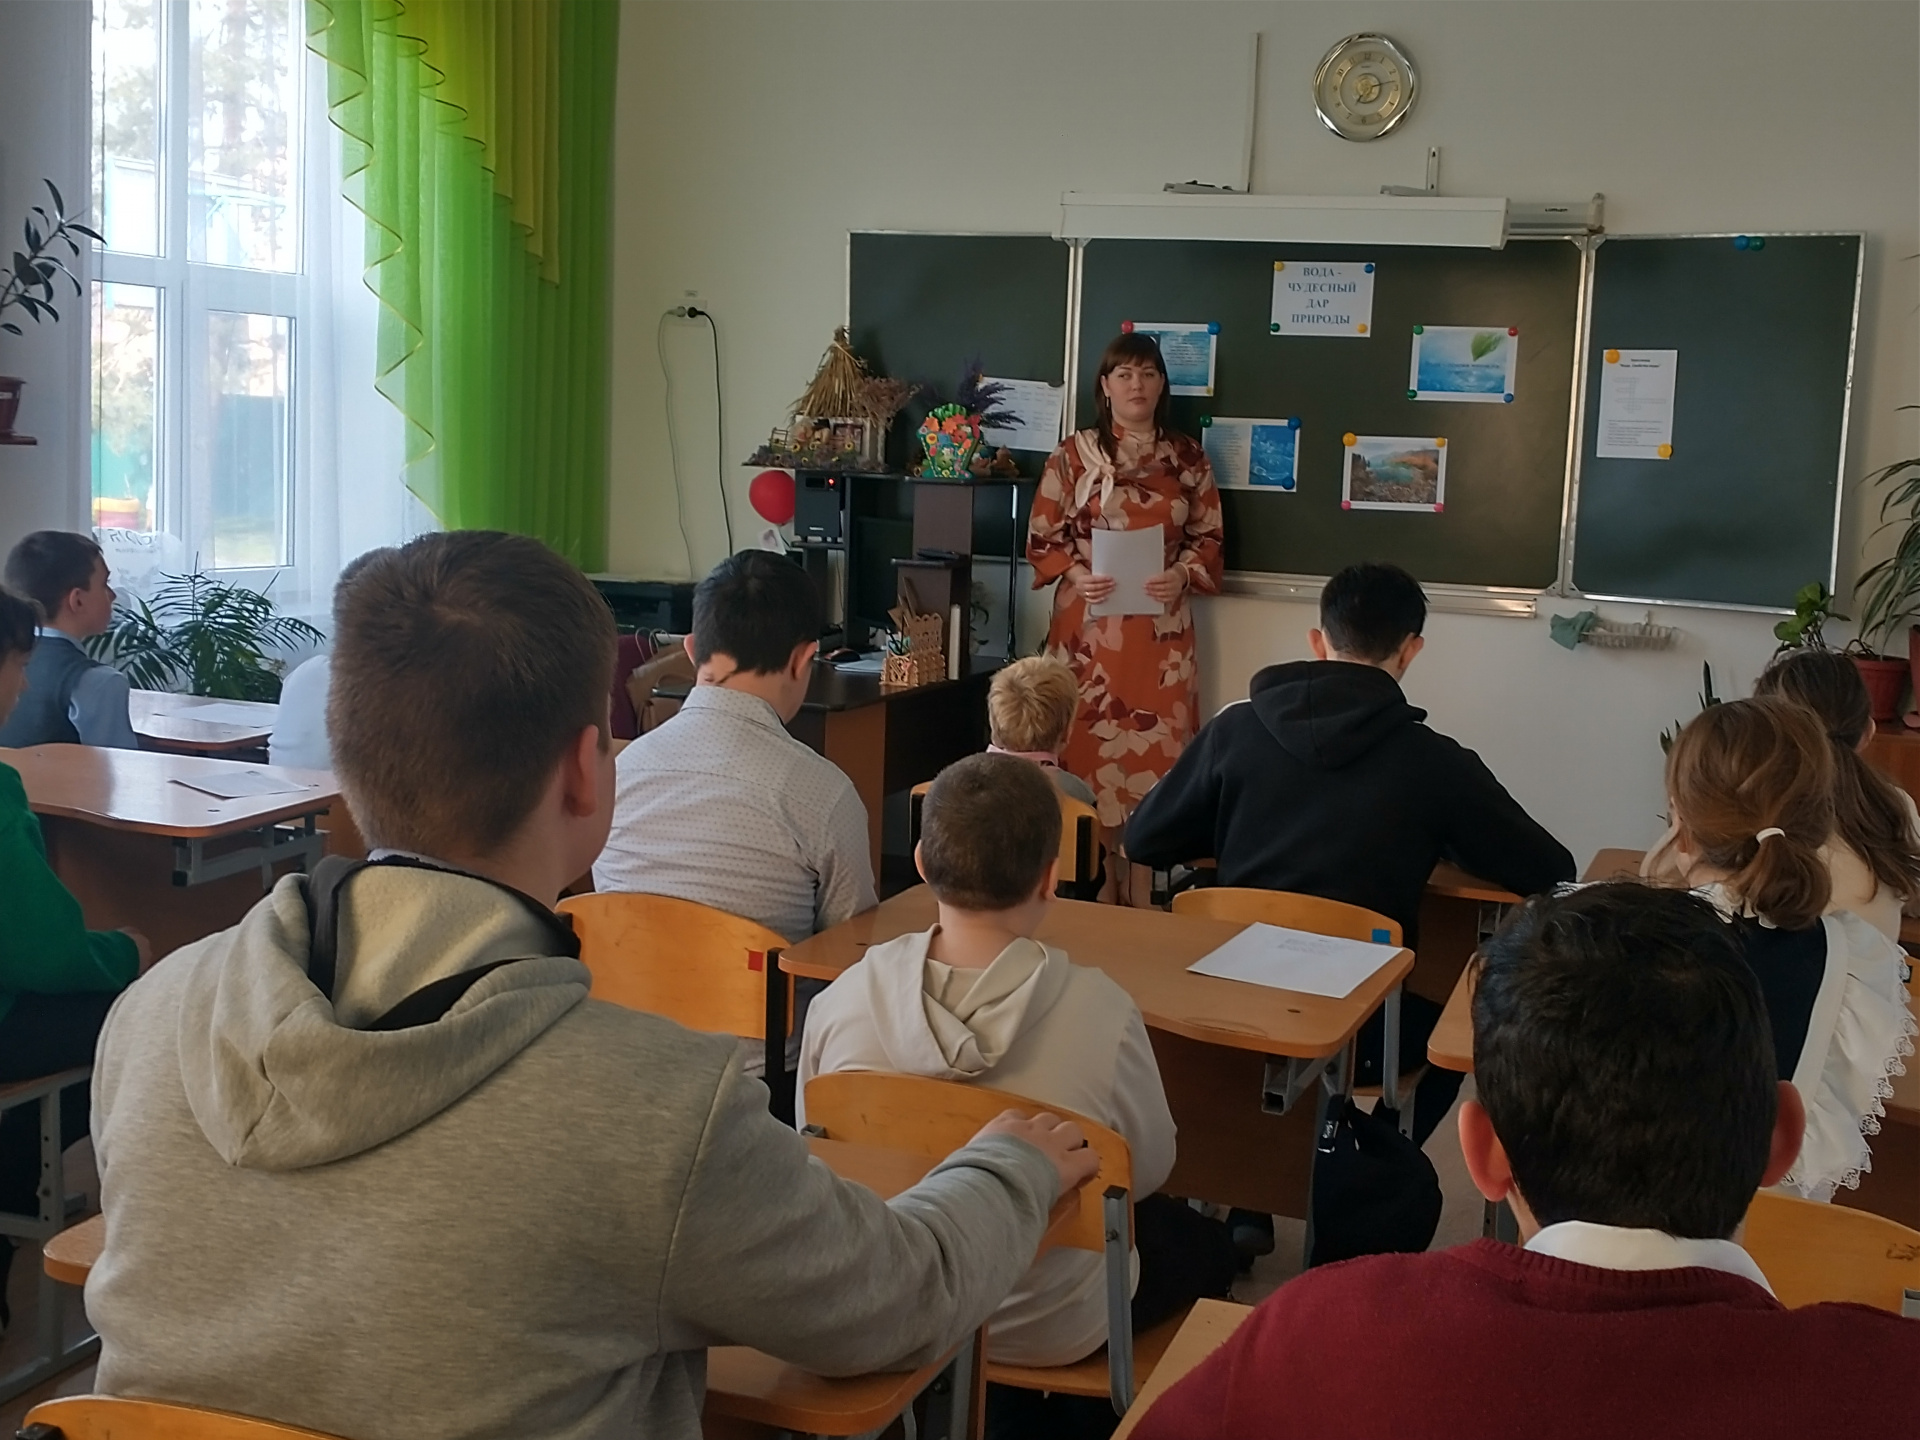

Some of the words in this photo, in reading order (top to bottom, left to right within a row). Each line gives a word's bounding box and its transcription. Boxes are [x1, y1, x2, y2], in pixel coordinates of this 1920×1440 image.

[1303, 267, 1335, 278] ВОДА
[1288, 281, 1357, 293] ЧУДЕСНЫЙ
[1305, 298, 1330, 309] ДАР
[1291, 313, 1351, 325] ПРИРОДЫ
